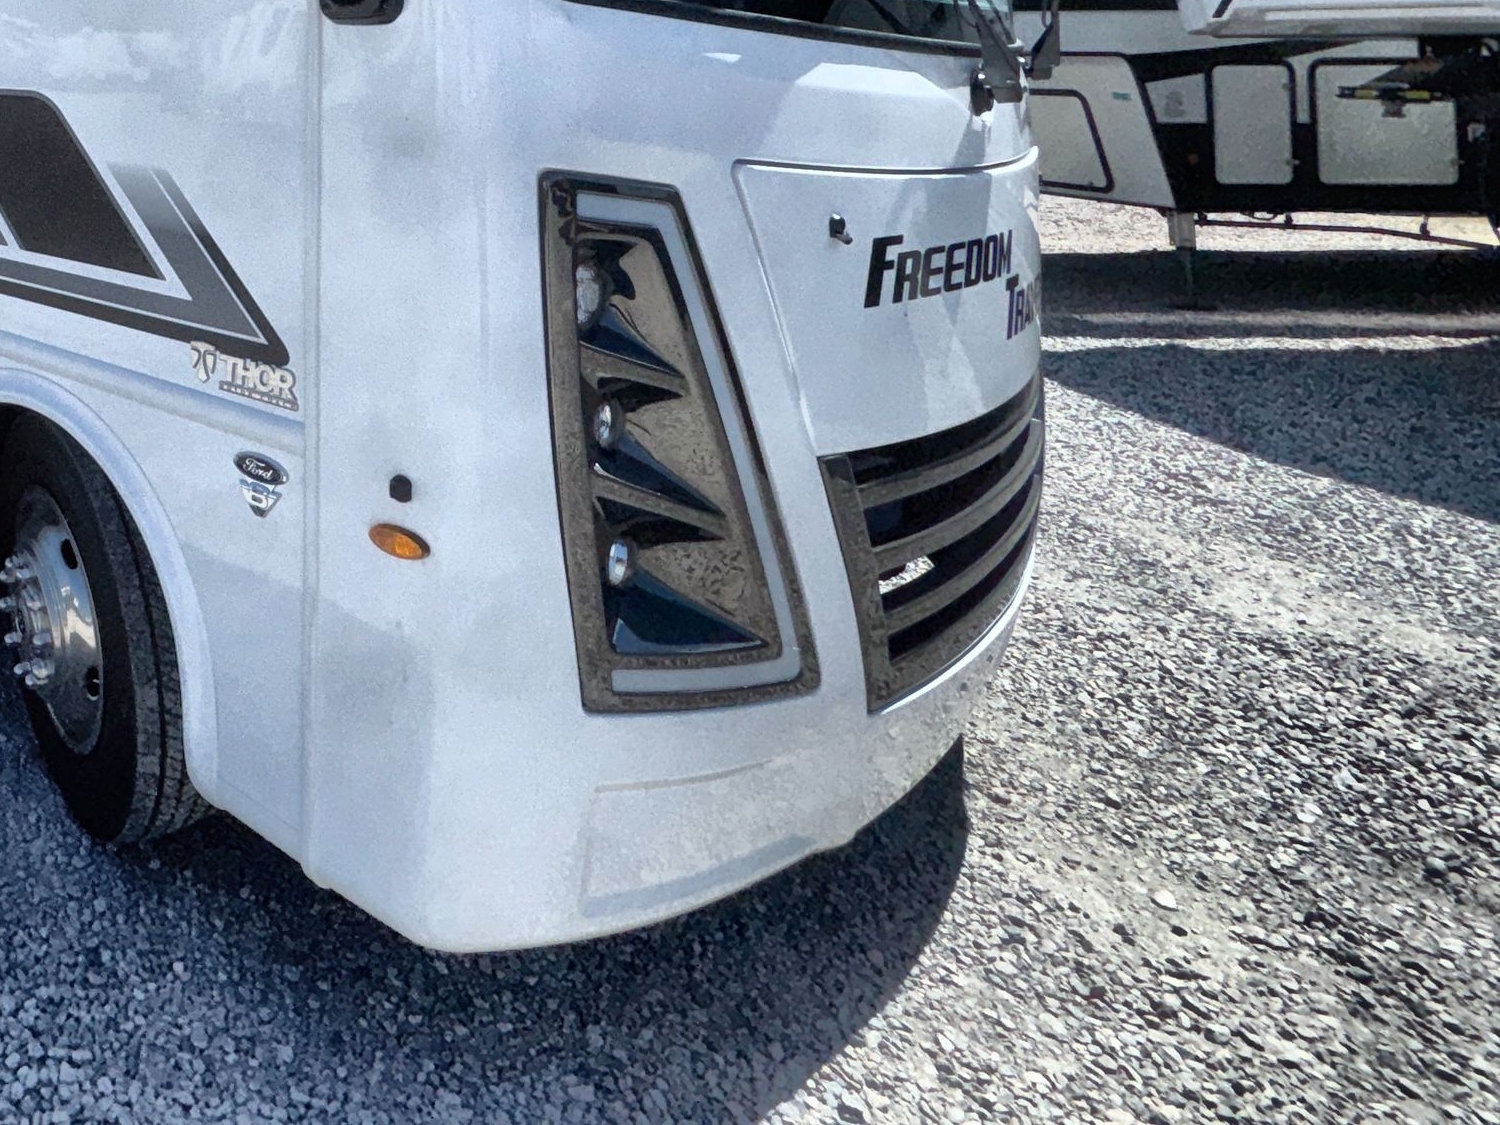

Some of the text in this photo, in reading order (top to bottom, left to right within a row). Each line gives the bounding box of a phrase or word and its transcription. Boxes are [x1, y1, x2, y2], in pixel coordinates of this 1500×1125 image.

[864, 229, 1013, 309] FREEDOM
[218, 353, 299, 402] THOR
[242, 457, 274, 481] Ford
